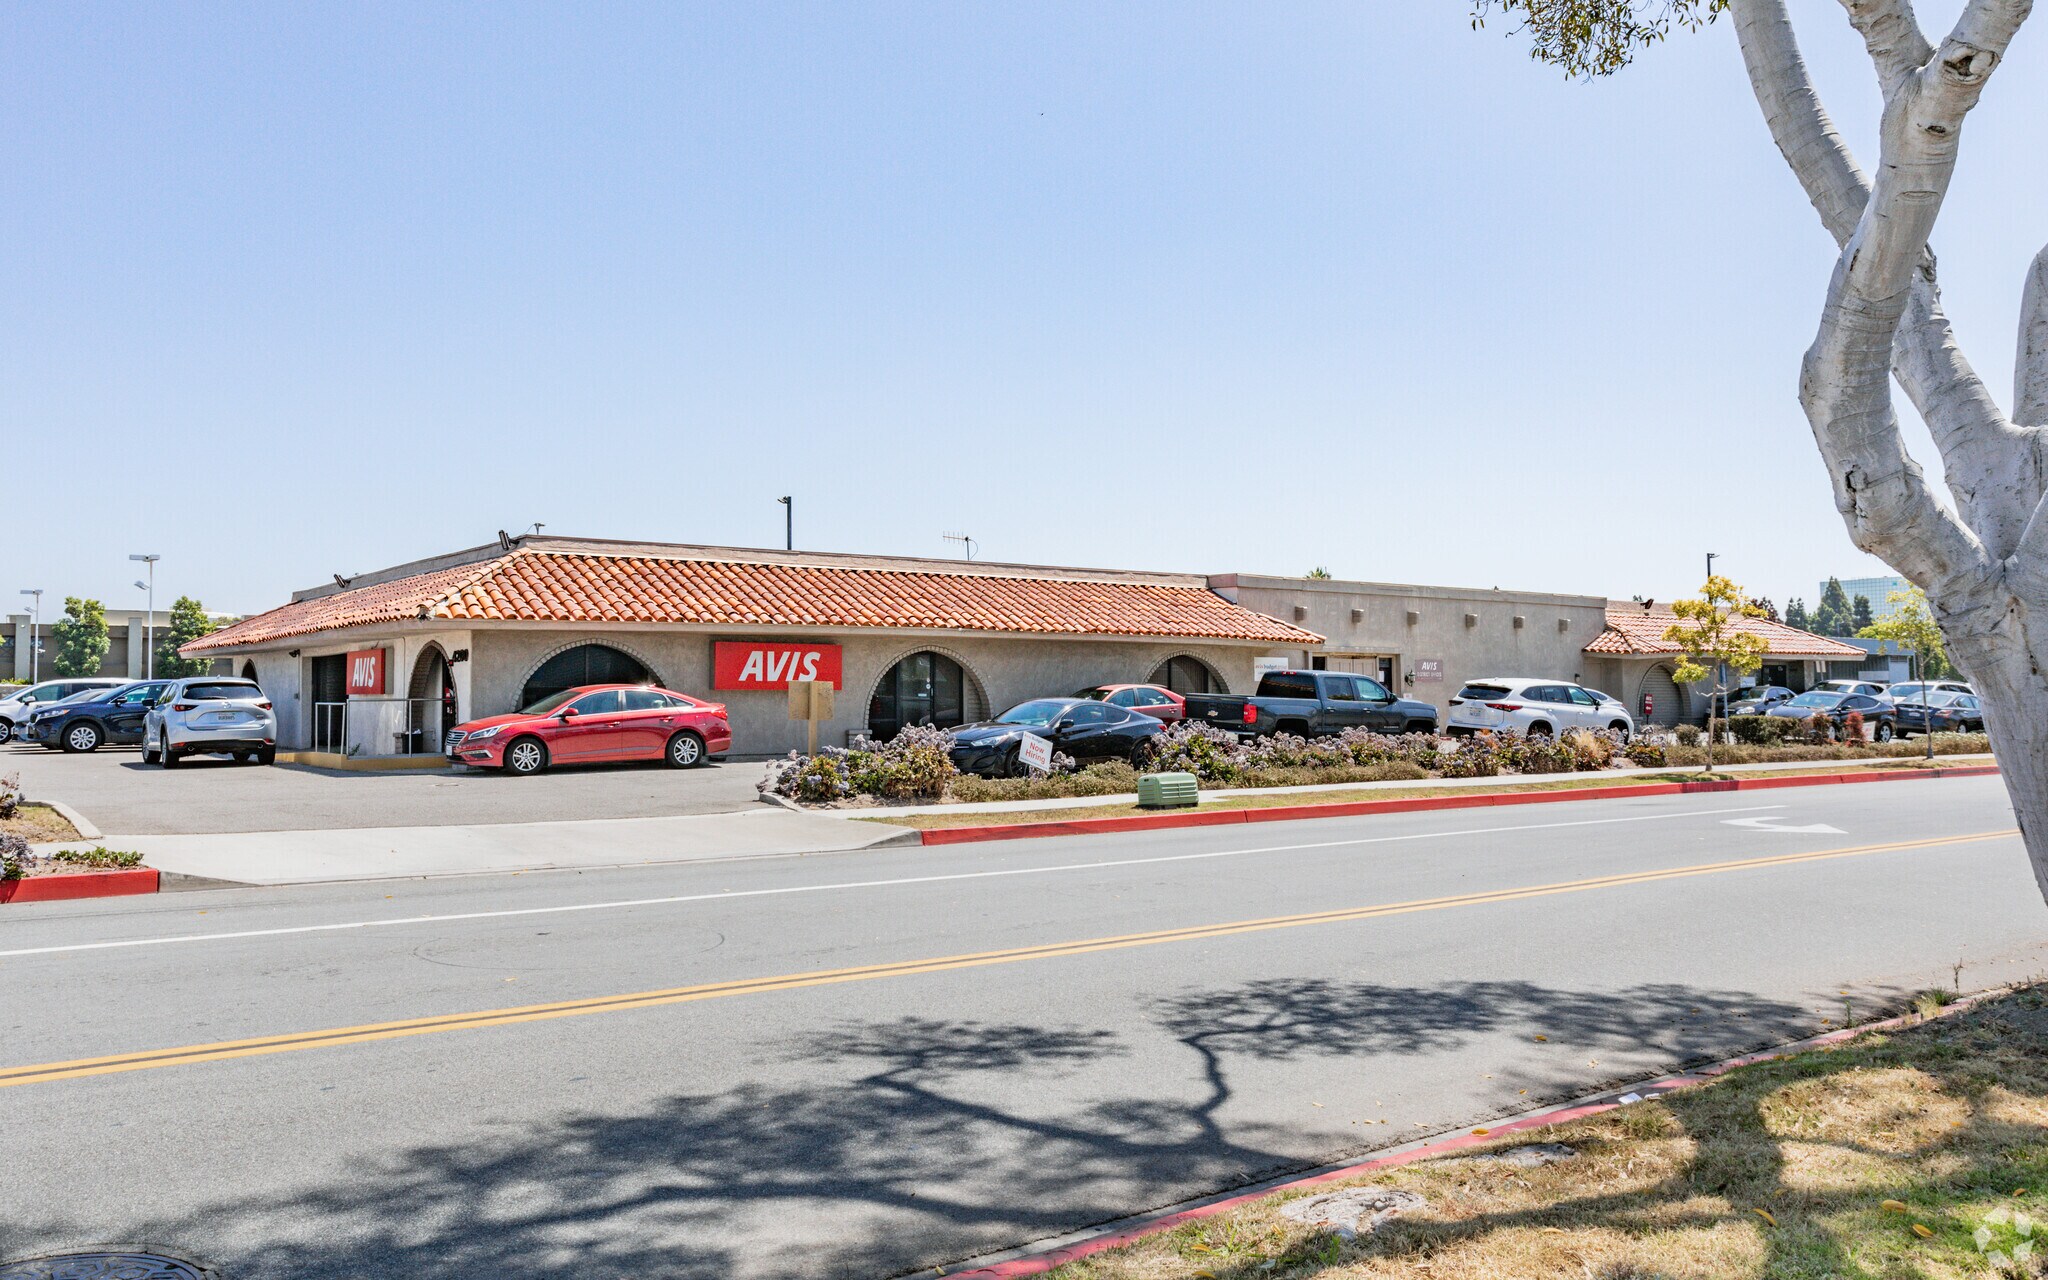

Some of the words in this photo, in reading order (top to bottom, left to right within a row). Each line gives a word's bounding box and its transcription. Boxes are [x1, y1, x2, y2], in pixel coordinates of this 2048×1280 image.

[352, 656, 376, 688] AVIS
[738, 651, 821, 682] AVIS
[1421, 662, 1437, 670] AVIS
[1030, 742, 1044, 753] Now
[1025, 749, 1045, 764] Hiring
